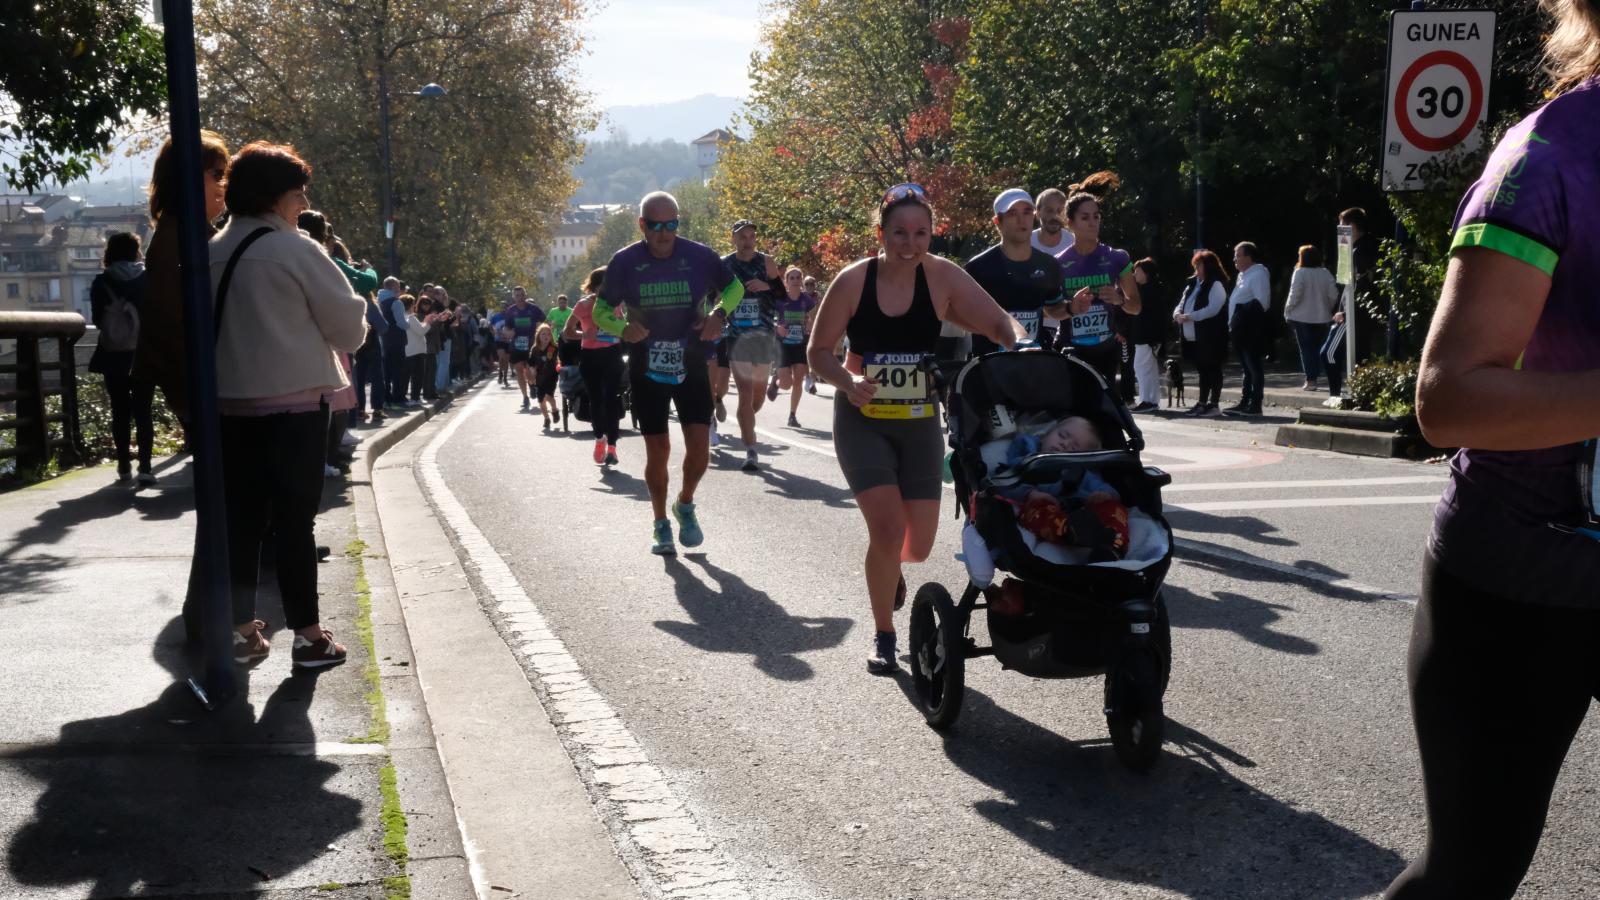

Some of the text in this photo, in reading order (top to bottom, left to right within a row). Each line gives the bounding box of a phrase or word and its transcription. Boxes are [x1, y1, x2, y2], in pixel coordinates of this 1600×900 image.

[1406, 22, 1480, 42] GUNEA
[1416, 86, 1464, 119] 30
[639, 281, 691, 297] BEHOBIA
[1073, 314, 1107, 329] 8027
[651, 350, 682, 365] 7383
[874, 367, 919, 388] 401
